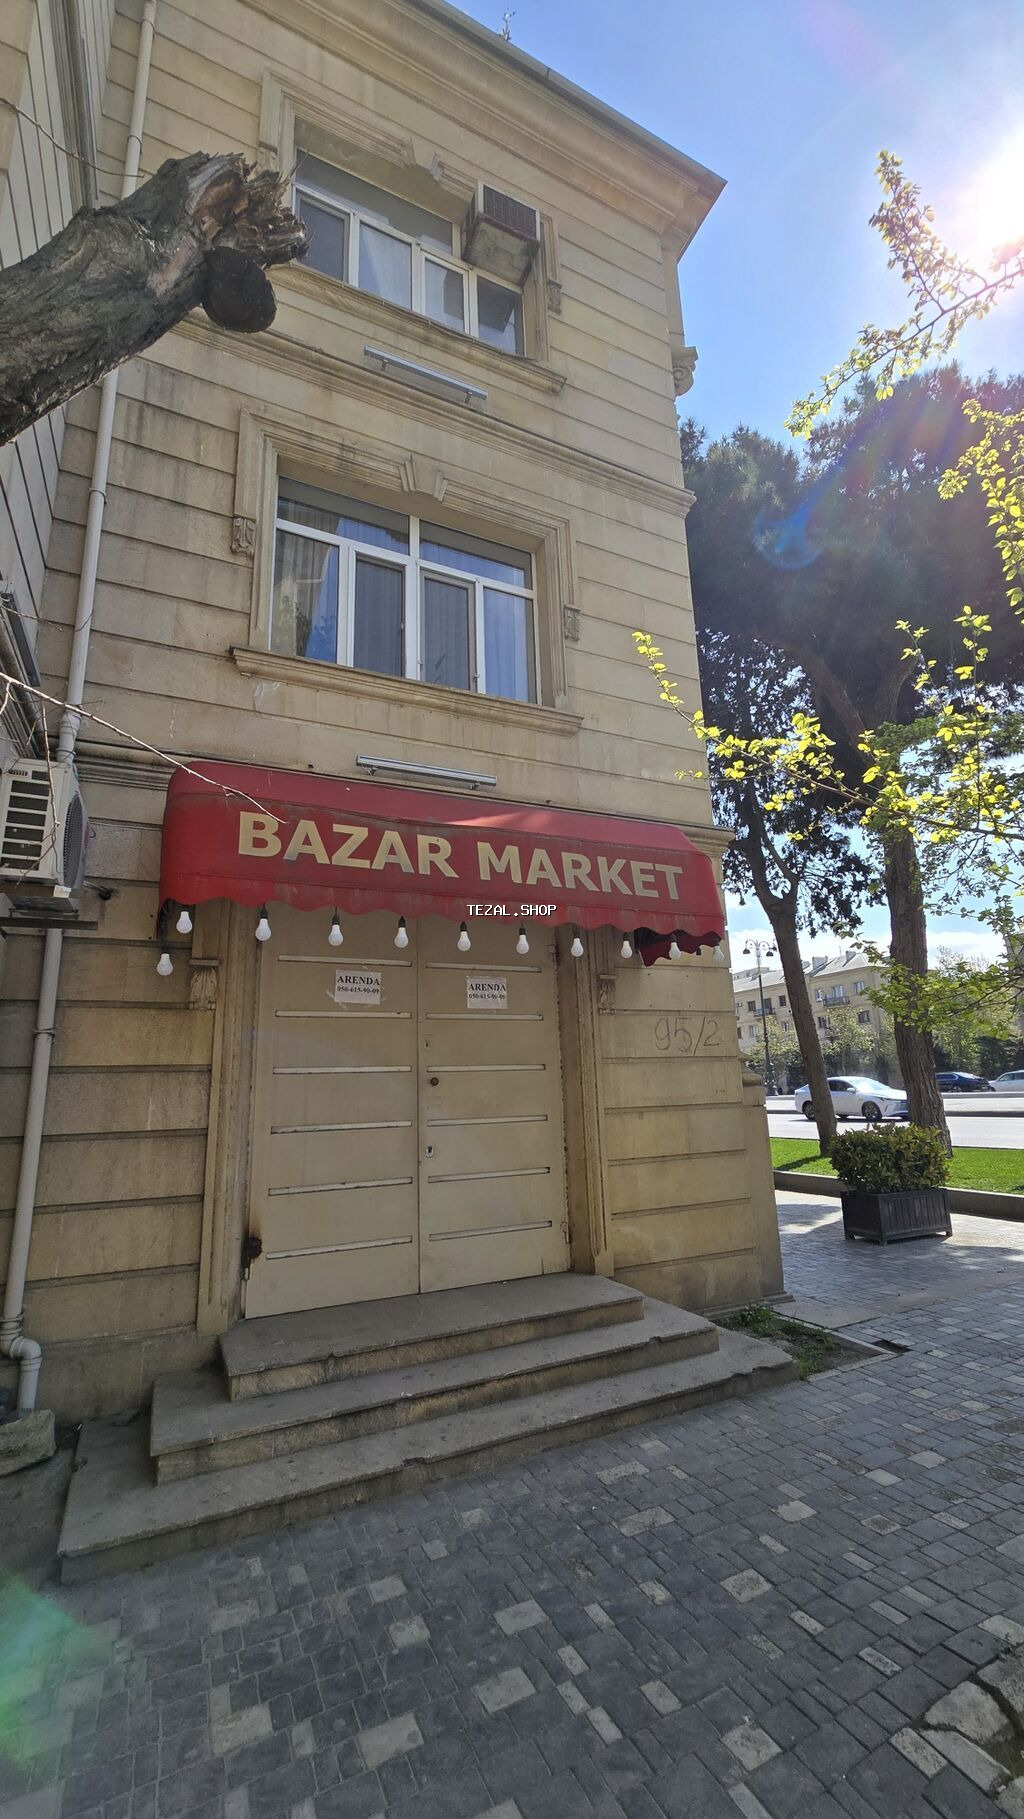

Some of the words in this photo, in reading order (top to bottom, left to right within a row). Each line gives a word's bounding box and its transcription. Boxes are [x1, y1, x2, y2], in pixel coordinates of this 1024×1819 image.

[238, 811, 460, 879] BAZAR
[477, 841, 684, 900] MARKET
[337, 975, 380, 986] ARENDA
[469, 983, 506, 992] ARENDA
[655, 1016, 720, 1056] 95/2
